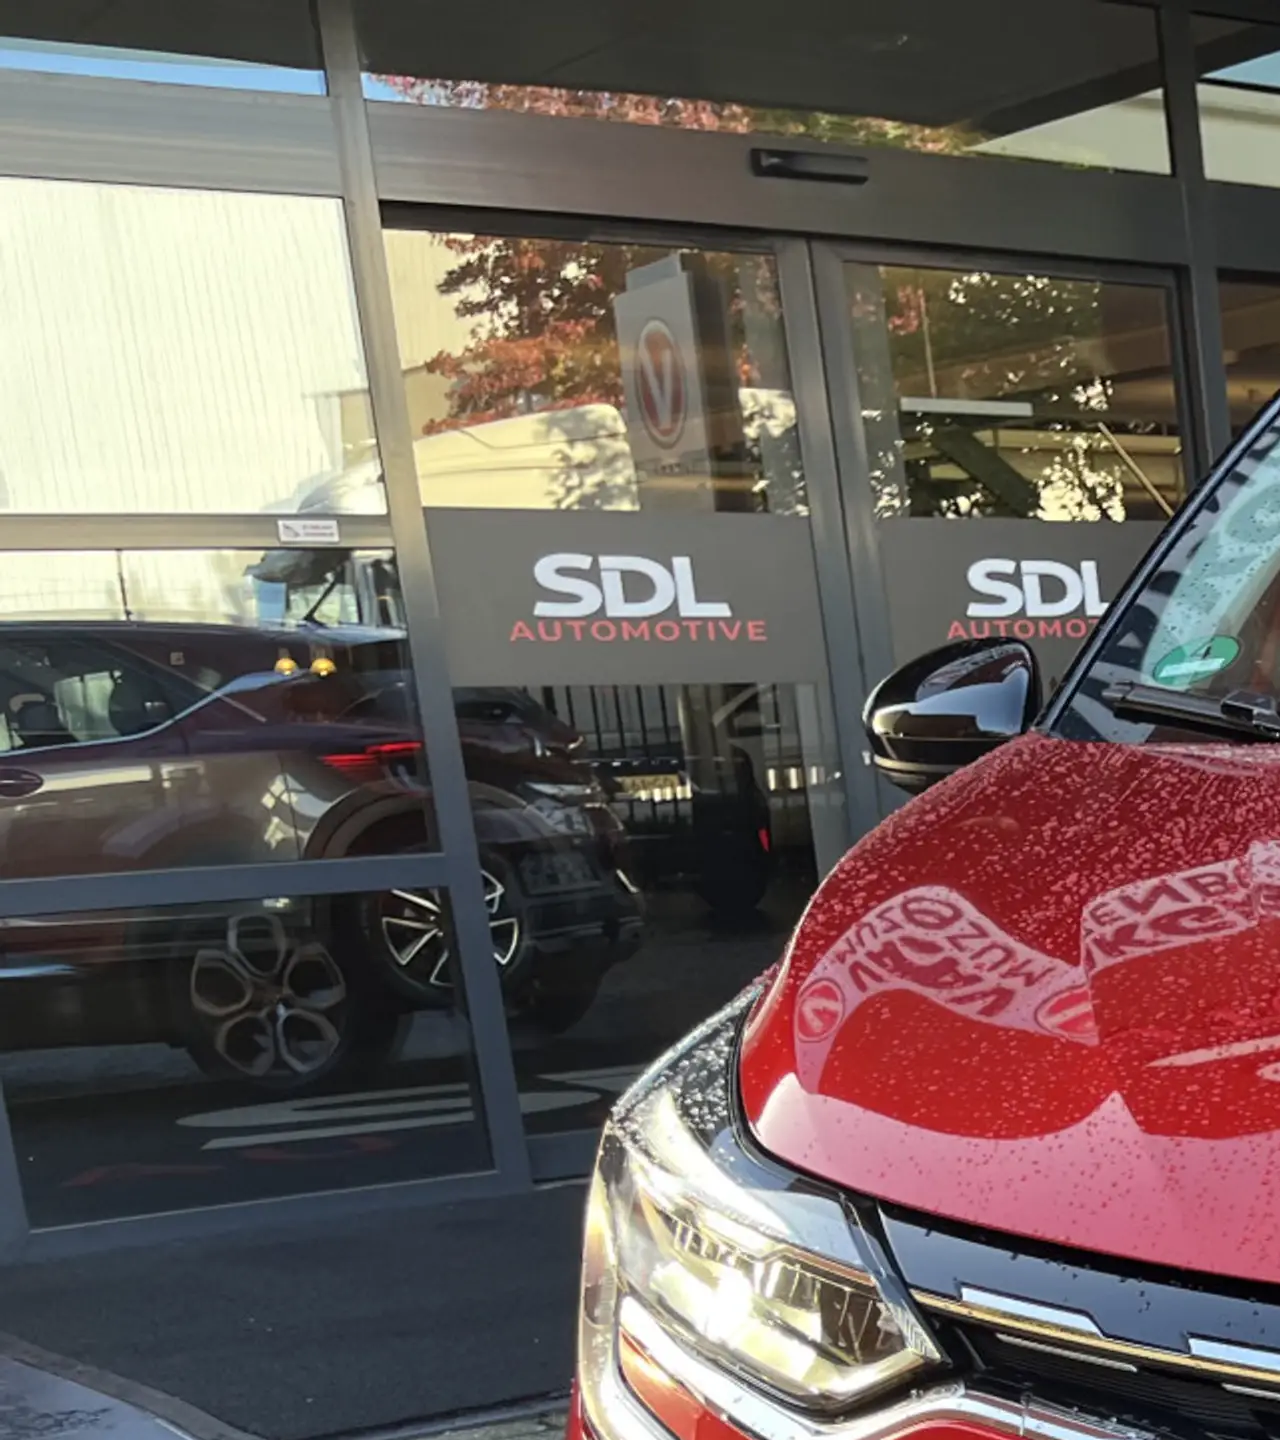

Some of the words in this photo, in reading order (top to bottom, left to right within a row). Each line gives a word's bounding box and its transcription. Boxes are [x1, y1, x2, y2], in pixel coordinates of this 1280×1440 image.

[533, 553, 732, 618] SDL
[966, 558, 1110, 617] SDL
[509, 620, 768, 642] AUTOMOTIVE
[947, 619, 1099, 640] AUTOMO
